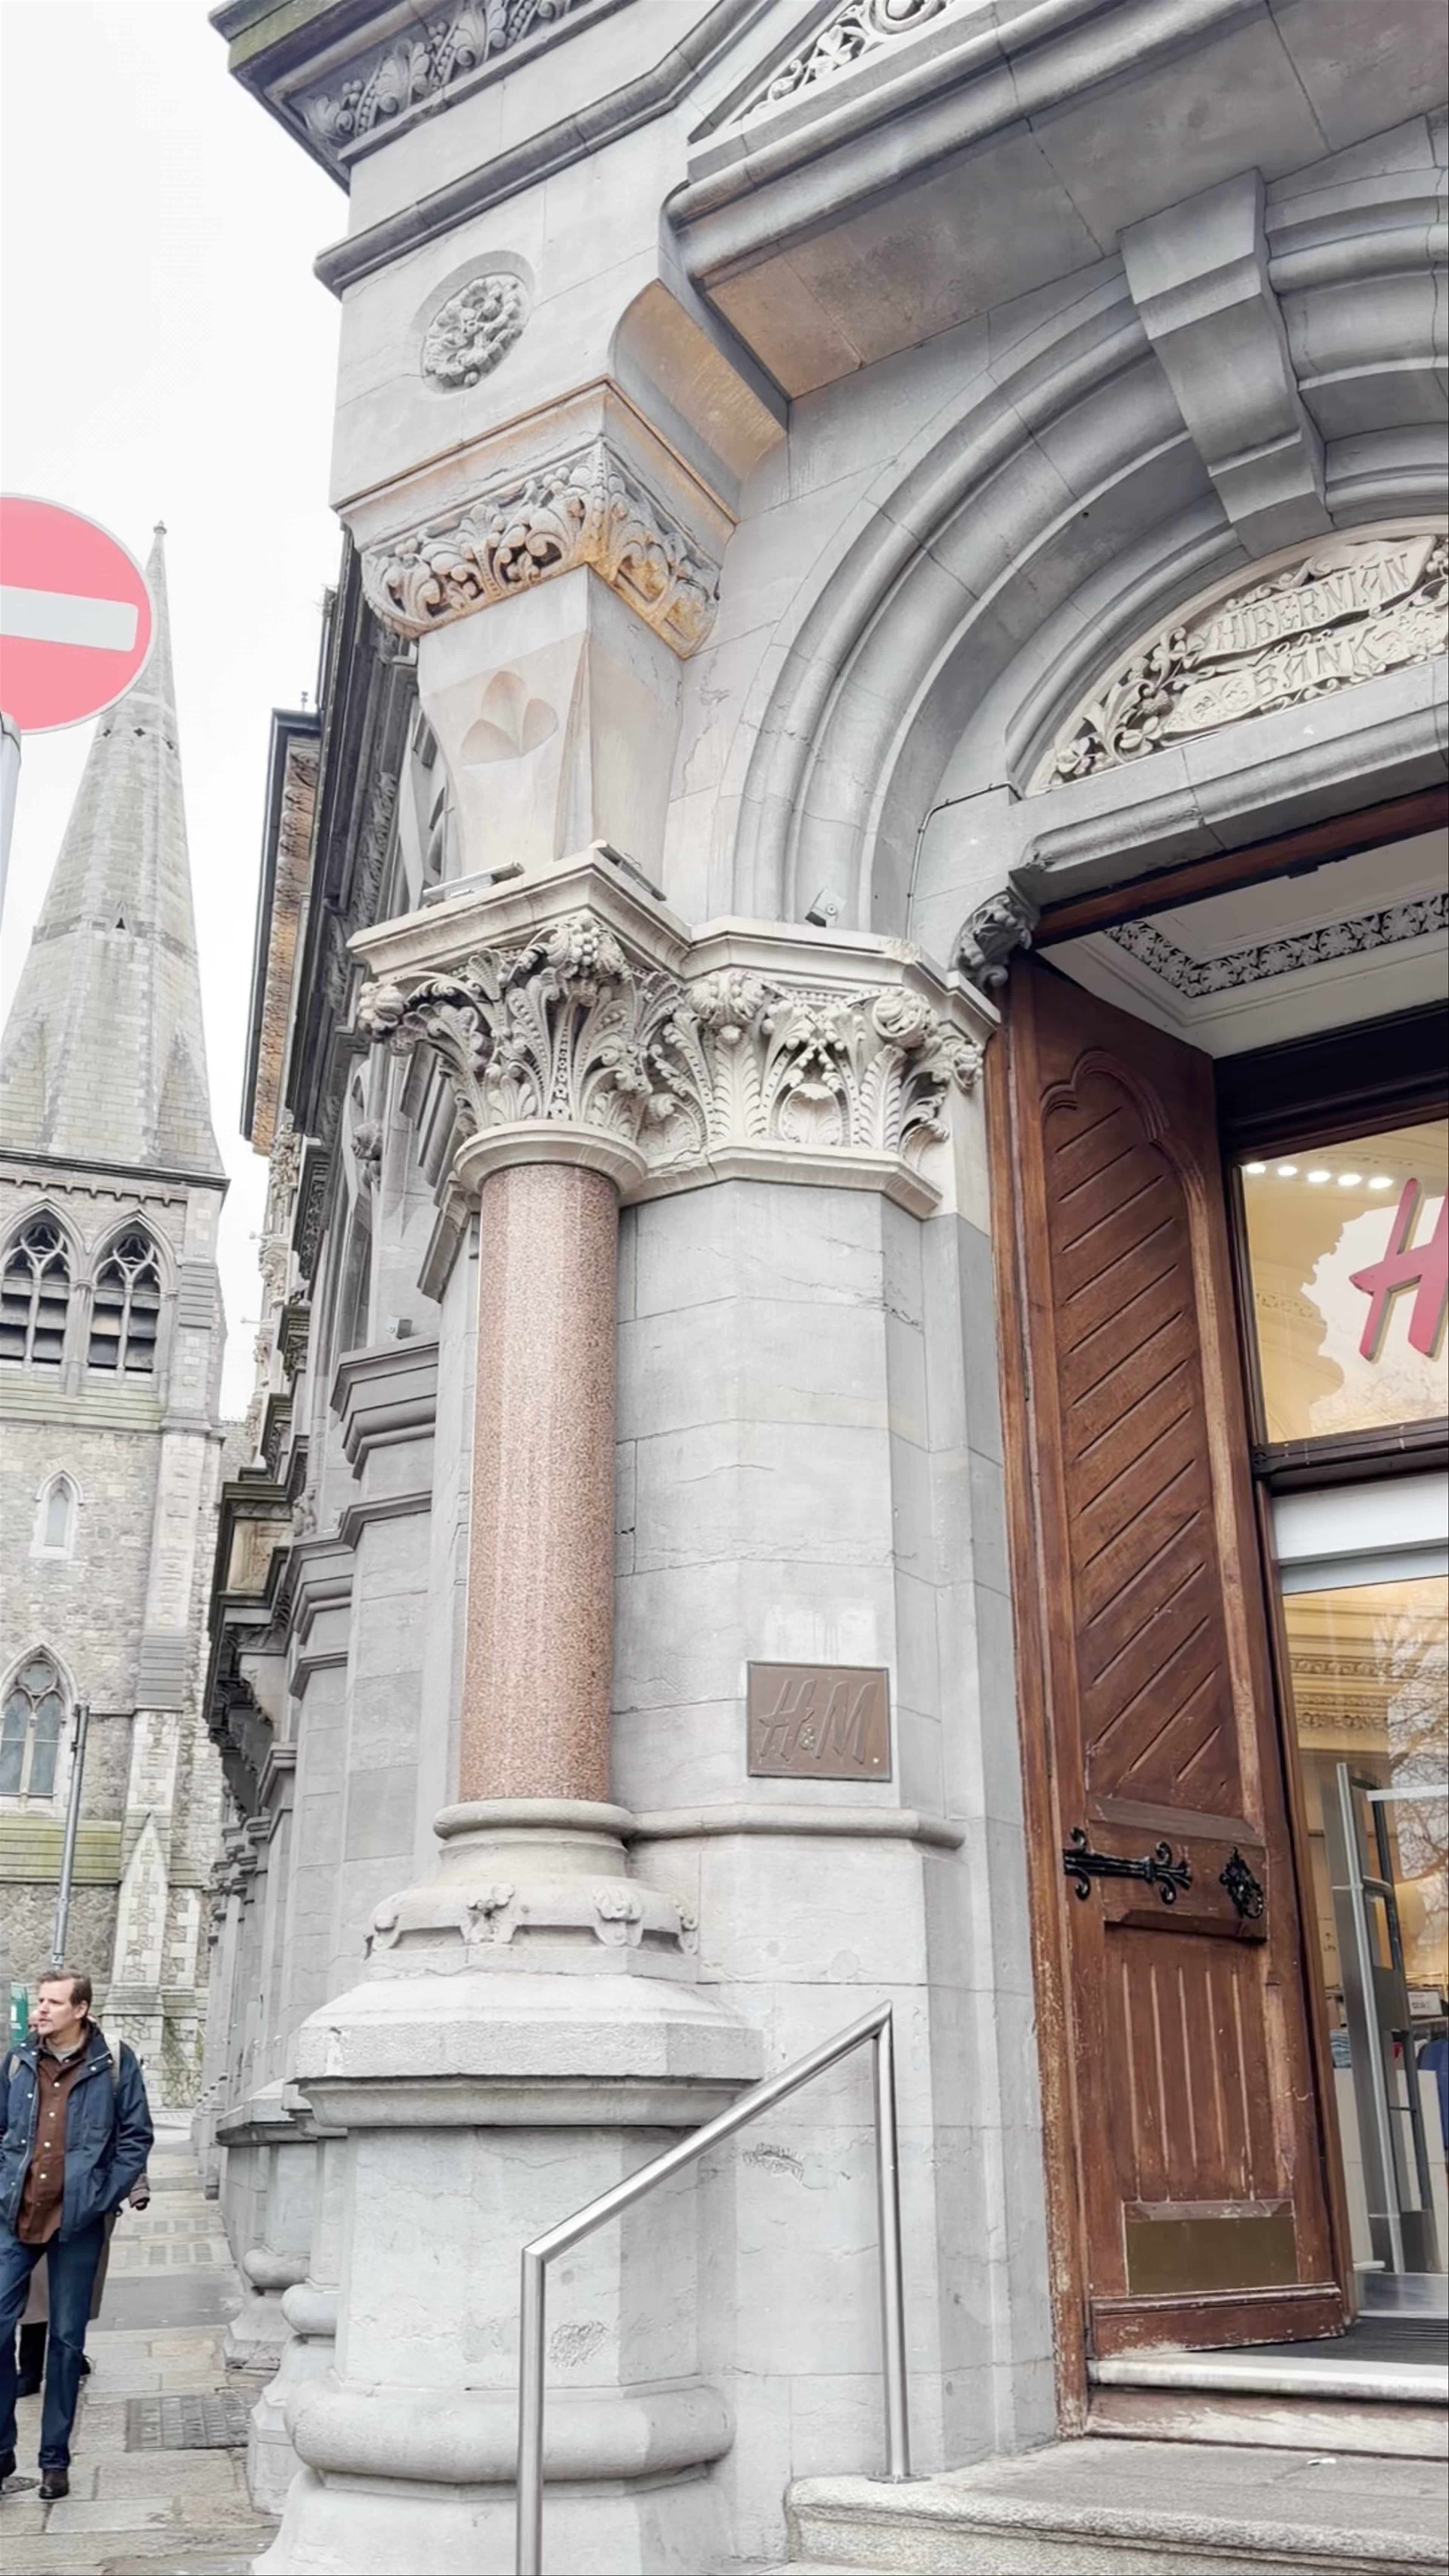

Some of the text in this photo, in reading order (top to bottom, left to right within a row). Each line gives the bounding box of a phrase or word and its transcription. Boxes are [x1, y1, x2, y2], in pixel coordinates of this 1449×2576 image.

[1217, 553, 1411, 651] HIBERNIAN
[1254, 625, 1381, 696] BANK
[758, 1678, 878, 1764] H&M
